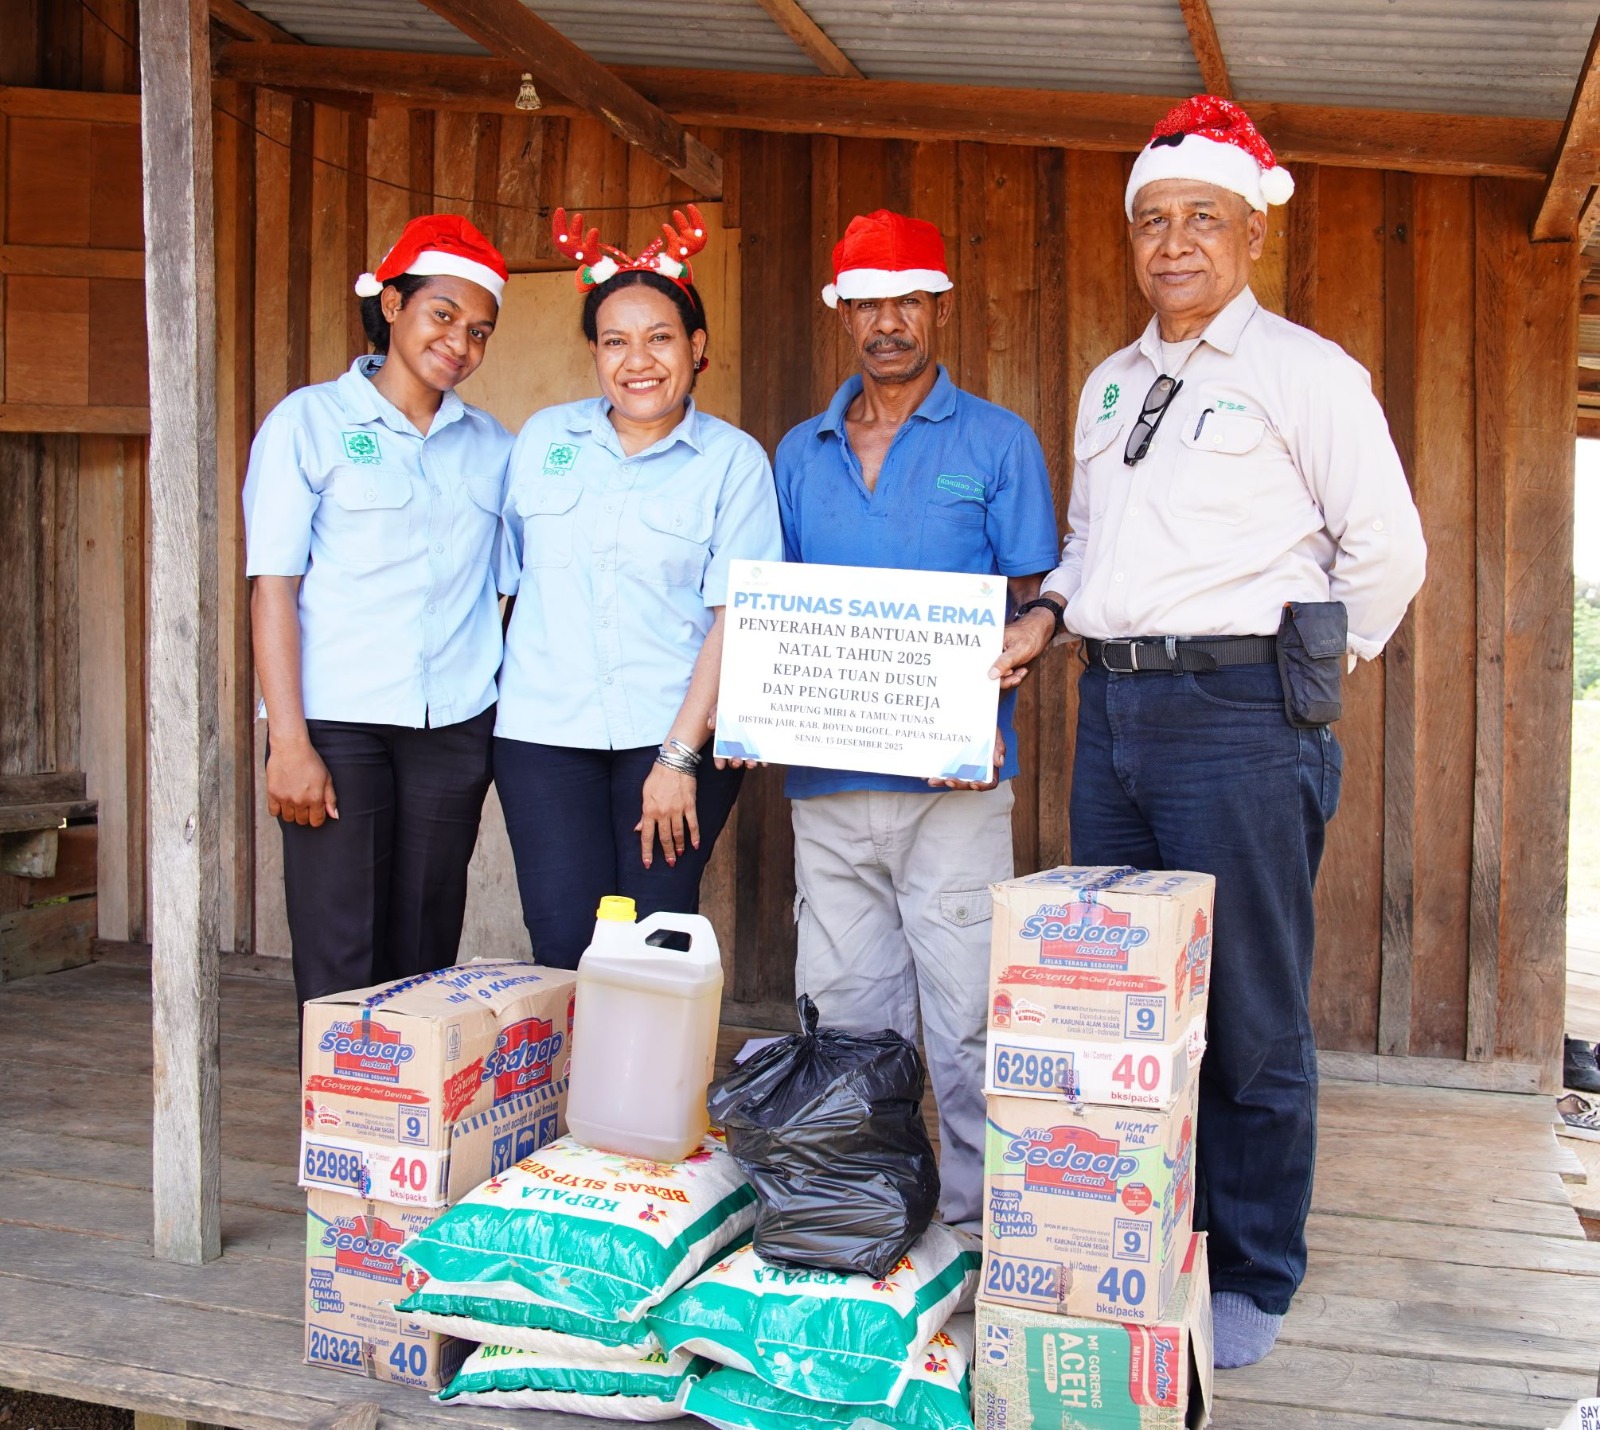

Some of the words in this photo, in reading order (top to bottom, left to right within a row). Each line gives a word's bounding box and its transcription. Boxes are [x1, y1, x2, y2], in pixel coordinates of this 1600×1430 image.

[733, 591, 843, 616] PT.TUNAS
[848, 599, 921, 621] SAWA
[927, 604, 996, 627] ERMA
[738, 617, 846, 637] PENYERAHAN
[850, 625, 929, 643] BANTUAN
[933, 632, 982, 648] BAMA
[778, 642, 832, 659] NATAL
[836, 646, 893, 663] TAHUN
[897, 651, 932, 666] 2025
[773, 663, 833, 680] KEPADA
[838, 668, 880, 683] TUAN
[884, 672, 938, 687] DUSUN
[762, 682, 794, 696] DAN
[798, 685, 879, 704] PENGURUS
[884, 693, 941, 710] GEREJA
[770, 702, 821, 715] KAMPUNG
[824, 707, 847, 717] MIRI
[849, 709, 857, 718] &
[860, 710, 897, 721] TAMUN
[900, 714, 935, 725] TUNAS
[738, 715, 774, 725] DISTRIK
[823, 722, 853, 732] BOVEN
[895, 729, 926, 739] PAPUA
[929, 732, 972, 743] SELATAN
[836, 737, 882, 749] DESEMBER
[884, 742, 903, 751] 2025
[1039, 904, 1067, 917] Mie
[1020, 916, 1149, 950] Sedaap
[1076, 945, 1117, 957] Instant
[1044, 958, 1063, 966] JELAS
[1065, 960, 1089, 968] TERASA
[1090, 962, 1123, 970] SEDAPNYA
[478, 989, 492, 999] 9
[489, 974, 543, 992] KARTON
[1022, 968, 1078, 985] Goreng
[1108, 978, 1144, 989] Devina
[331, 1020, 353, 1034] Mie
[1060, 1018, 1084, 1026] KARUNIA
[1136, 1008, 1156, 1031] 9
[318, 1033, 415, 1063] Sedaap
[481, 1031, 564, 1082] Sedaap
[360, 1059, 391, 1070] Instant
[1112, 1054, 1160, 1091] 40
[321, 1078, 362, 1093] Goreng
[385, 1090, 412, 1100] Devina
[1111, 1091, 1160, 1103] bks/packs
[407, 1117, 421, 1137] 9
[1022, 1128, 1053, 1141] Mie
[1115, 1121, 1159, 1134] NIKMAT
[306, 1148, 359, 1183] 62988
[1003, 1141, 1139, 1181] Sedaap
[390, 1157, 427, 1191] 40
[552, 1171, 607, 1194] SLYP
[1062, 1172, 1105, 1186] Instant
[520, 1186, 622, 1213] KEPALA
[613, 1181, 691, 1205] BERAS
[1050, 1188, 1075, 1196] TERASA
[1077, 1192, 1112, 1201] SEDAPNYA
[990, 1200, 1018, 1211] AYAM
[334, 1216, 356, 1229] Mie
[995, 1212, 1032, 1223] BAKAR
[1001, 1225, 1037, 1235] LIMAU
[1054, 1237, 1076, 1246] KARUNIA
[1123, 1231, 1141, 1253] 9
[362, 1258, 394, 1271] Instant
[310, 1279, 331, 1289] AYAM
[372, 1273, 399, 1284] SEDAPNYA
[988, 1259, 1057, 1298] 20322
[1097, 1267, 1146, 1306] 40
[314, 1290, 341, 1301] BAKAR
[319, 1301, 344, 1312] LIMAU
[1096, 1303, 1145, 1318] bks/packs
[310, 1331, 363, 1366] 20322
[1087, 1334, 1099, 1350] MI
[389, 1342, 428, 1377] 40
[1058, 1332, 1087, 1409] ACEH
[1131, 1354, 1141, 1382] Instan
[391, 1372, 428, 1387] bks/packs
[1088, 1357, 1102, 1409] GORENG
